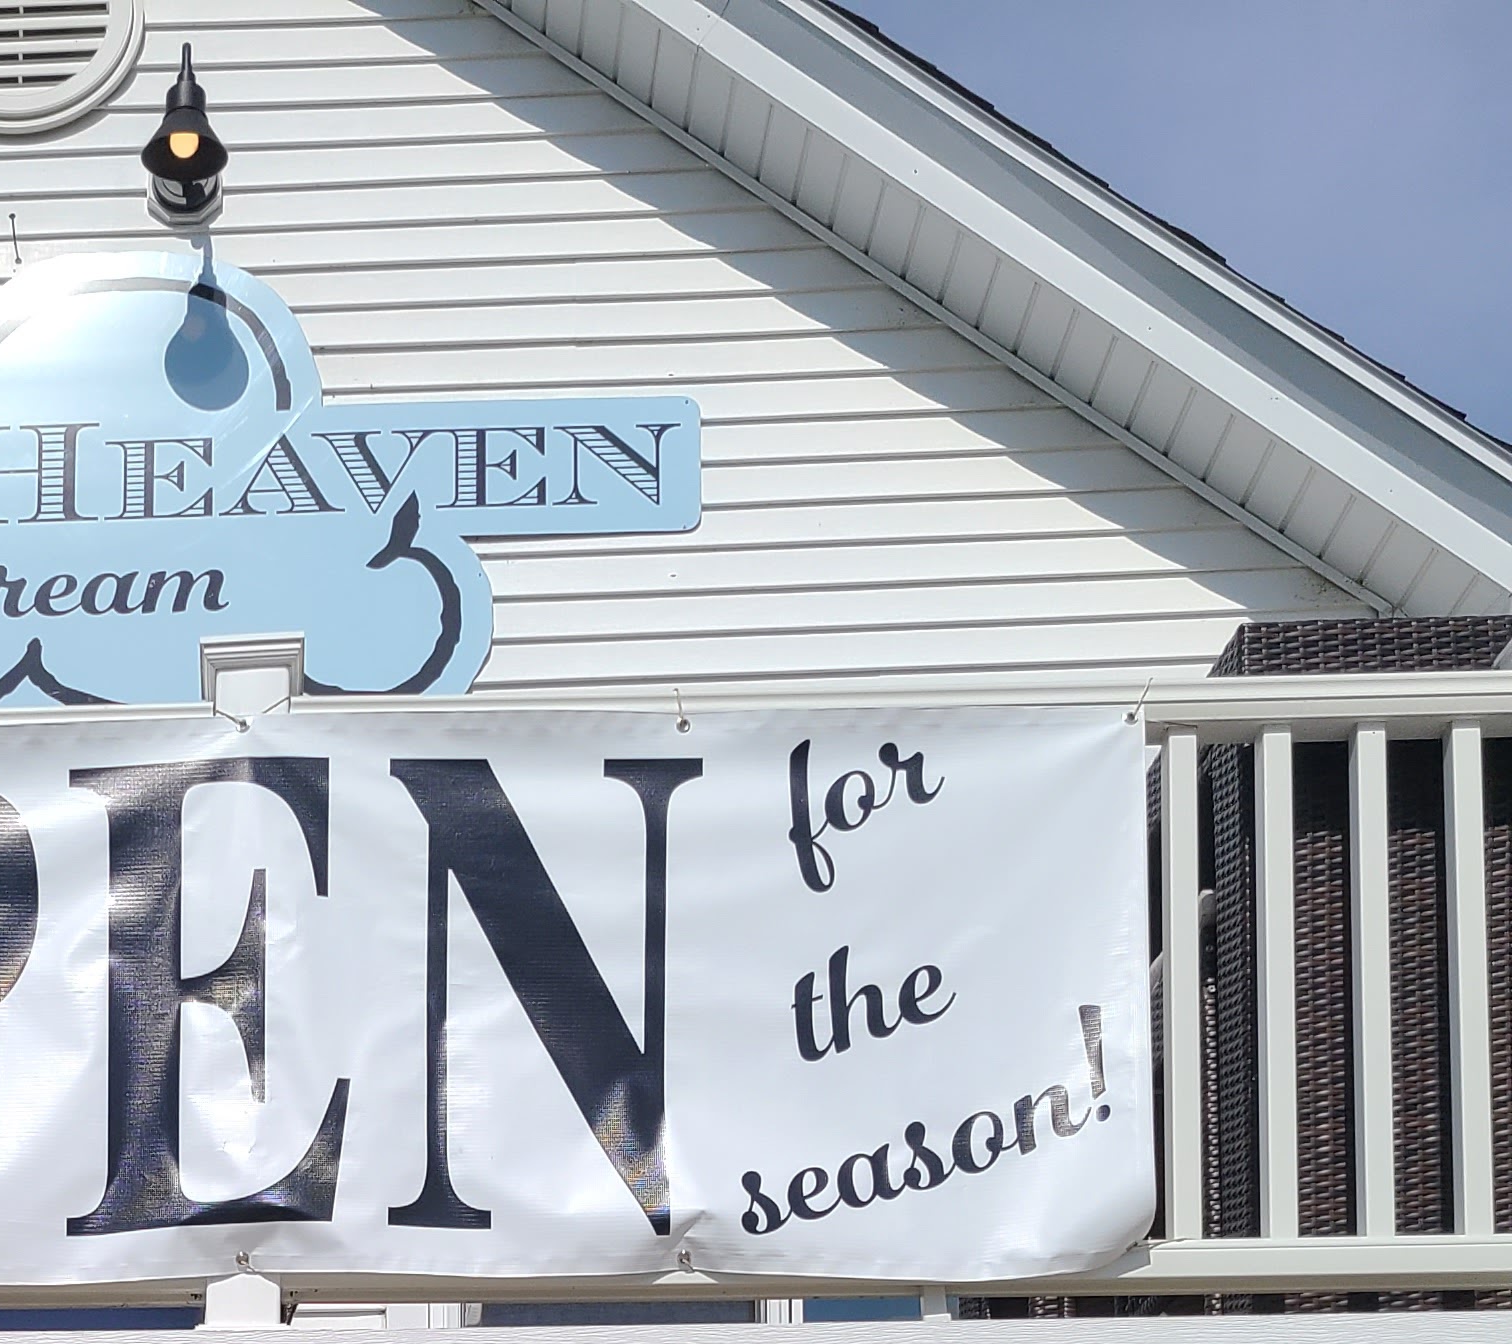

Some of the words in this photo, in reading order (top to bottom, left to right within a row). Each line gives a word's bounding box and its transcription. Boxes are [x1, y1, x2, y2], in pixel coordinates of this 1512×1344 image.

[788, 738, 945, 894] for
[790, 944, 957, 1062] the
[740, 1003, 1112, 1236] season!
